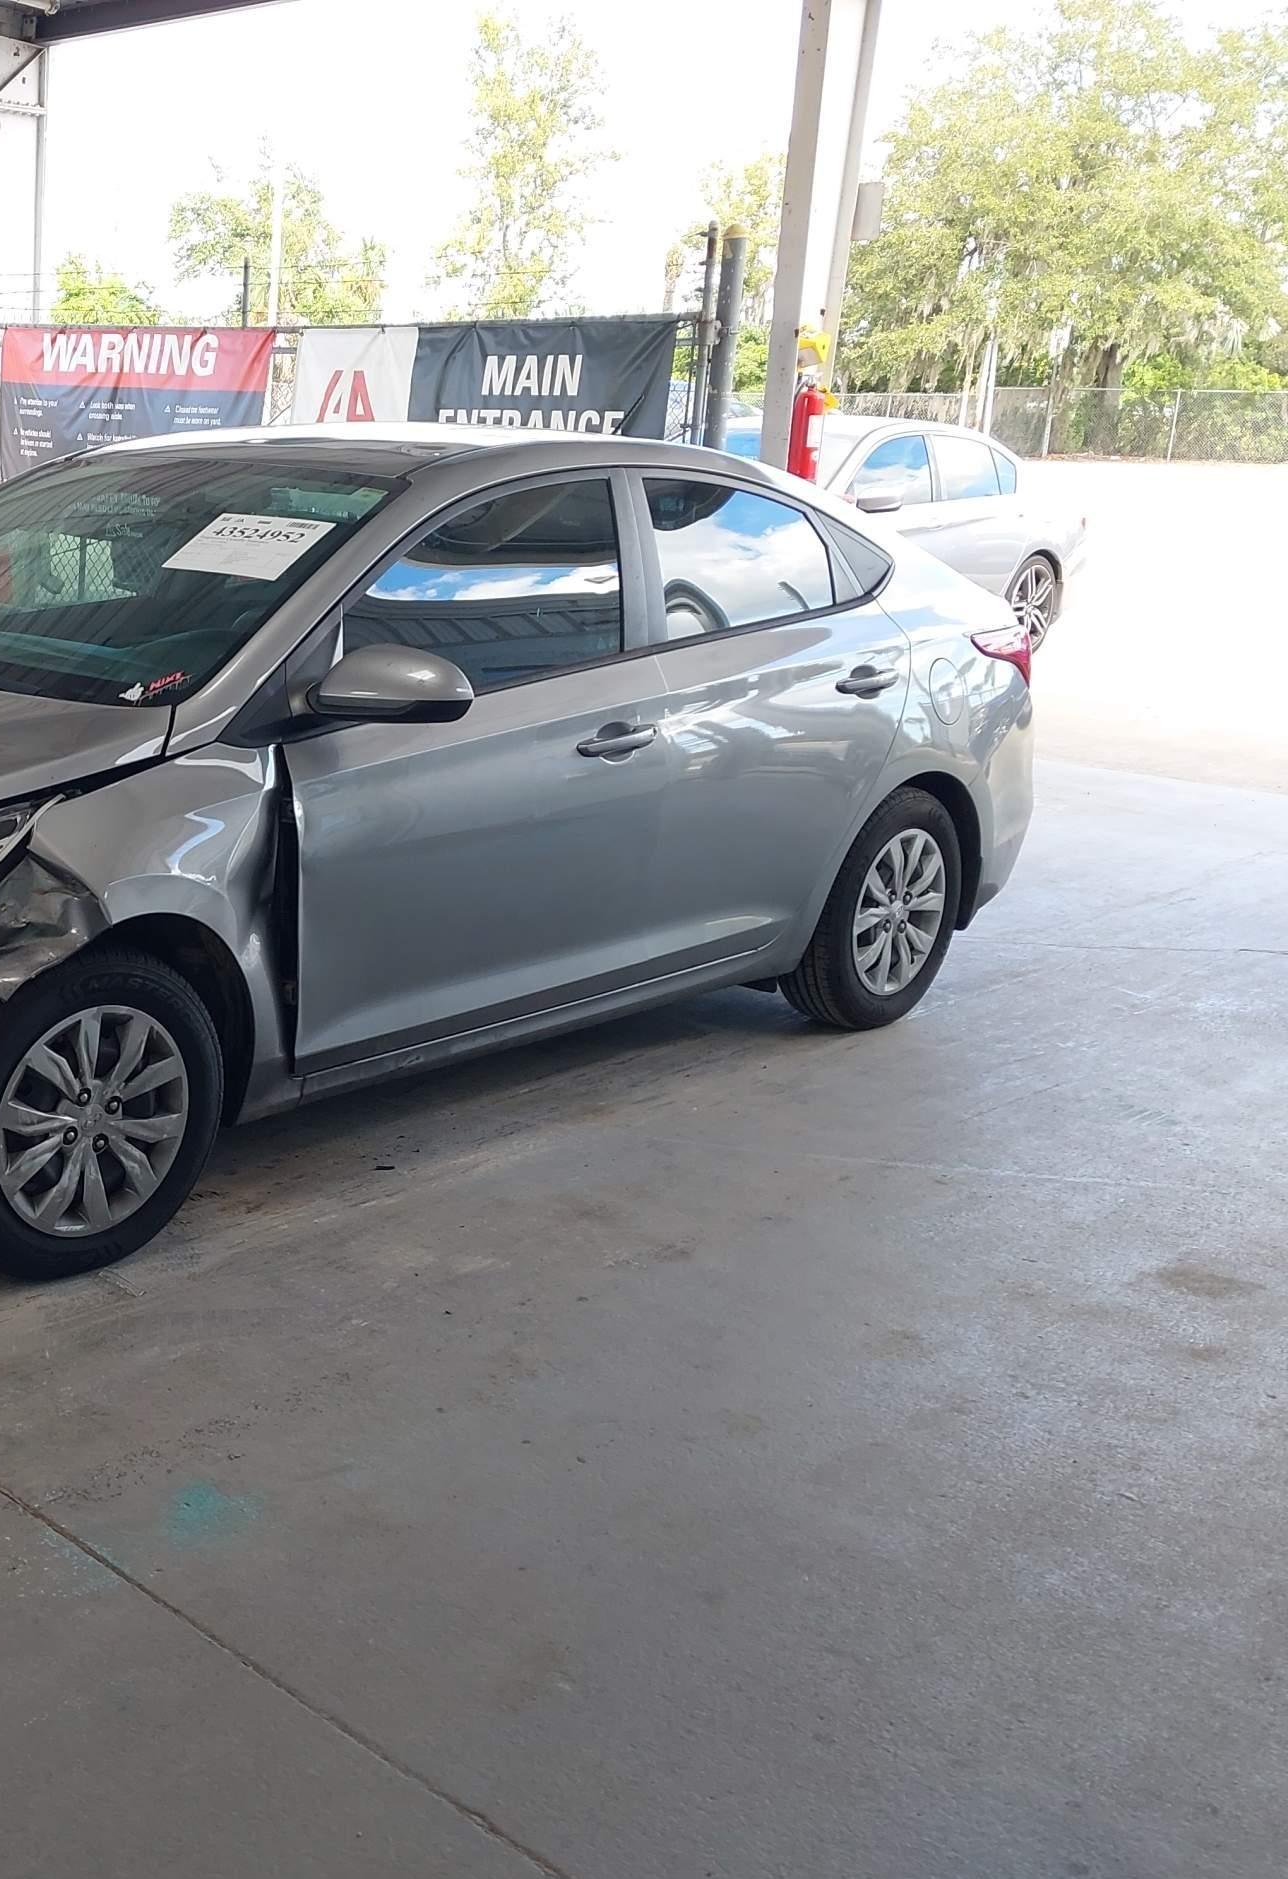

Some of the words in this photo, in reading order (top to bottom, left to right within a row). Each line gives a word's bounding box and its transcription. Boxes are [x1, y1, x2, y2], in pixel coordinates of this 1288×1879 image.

[41, 332, 219, 376] WARNING
[481, 354, 583, 397] MAIN
[212, 526, 306, 544] 43524952
